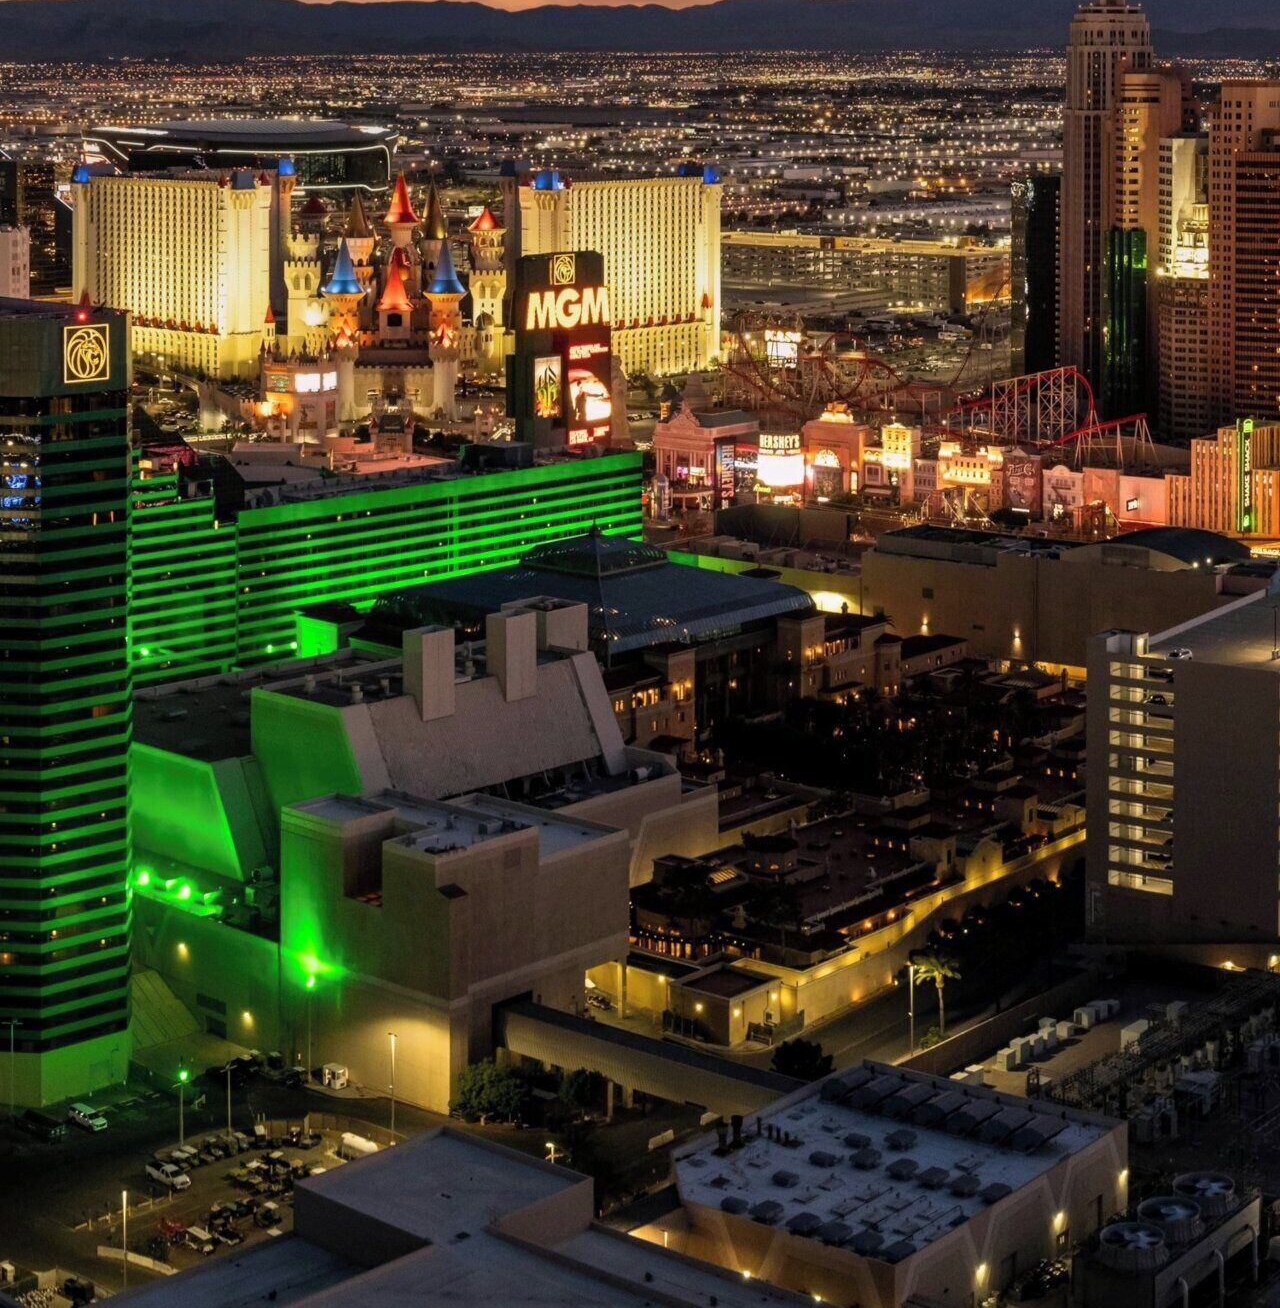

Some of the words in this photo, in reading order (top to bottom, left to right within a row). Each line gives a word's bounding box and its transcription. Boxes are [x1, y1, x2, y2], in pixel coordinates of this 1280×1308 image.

[526, 286, 610, 331] MGM
[759, 434, 800, 449] HERSHEY'S
[721, 444, 734, 498] HERSHEY'S
